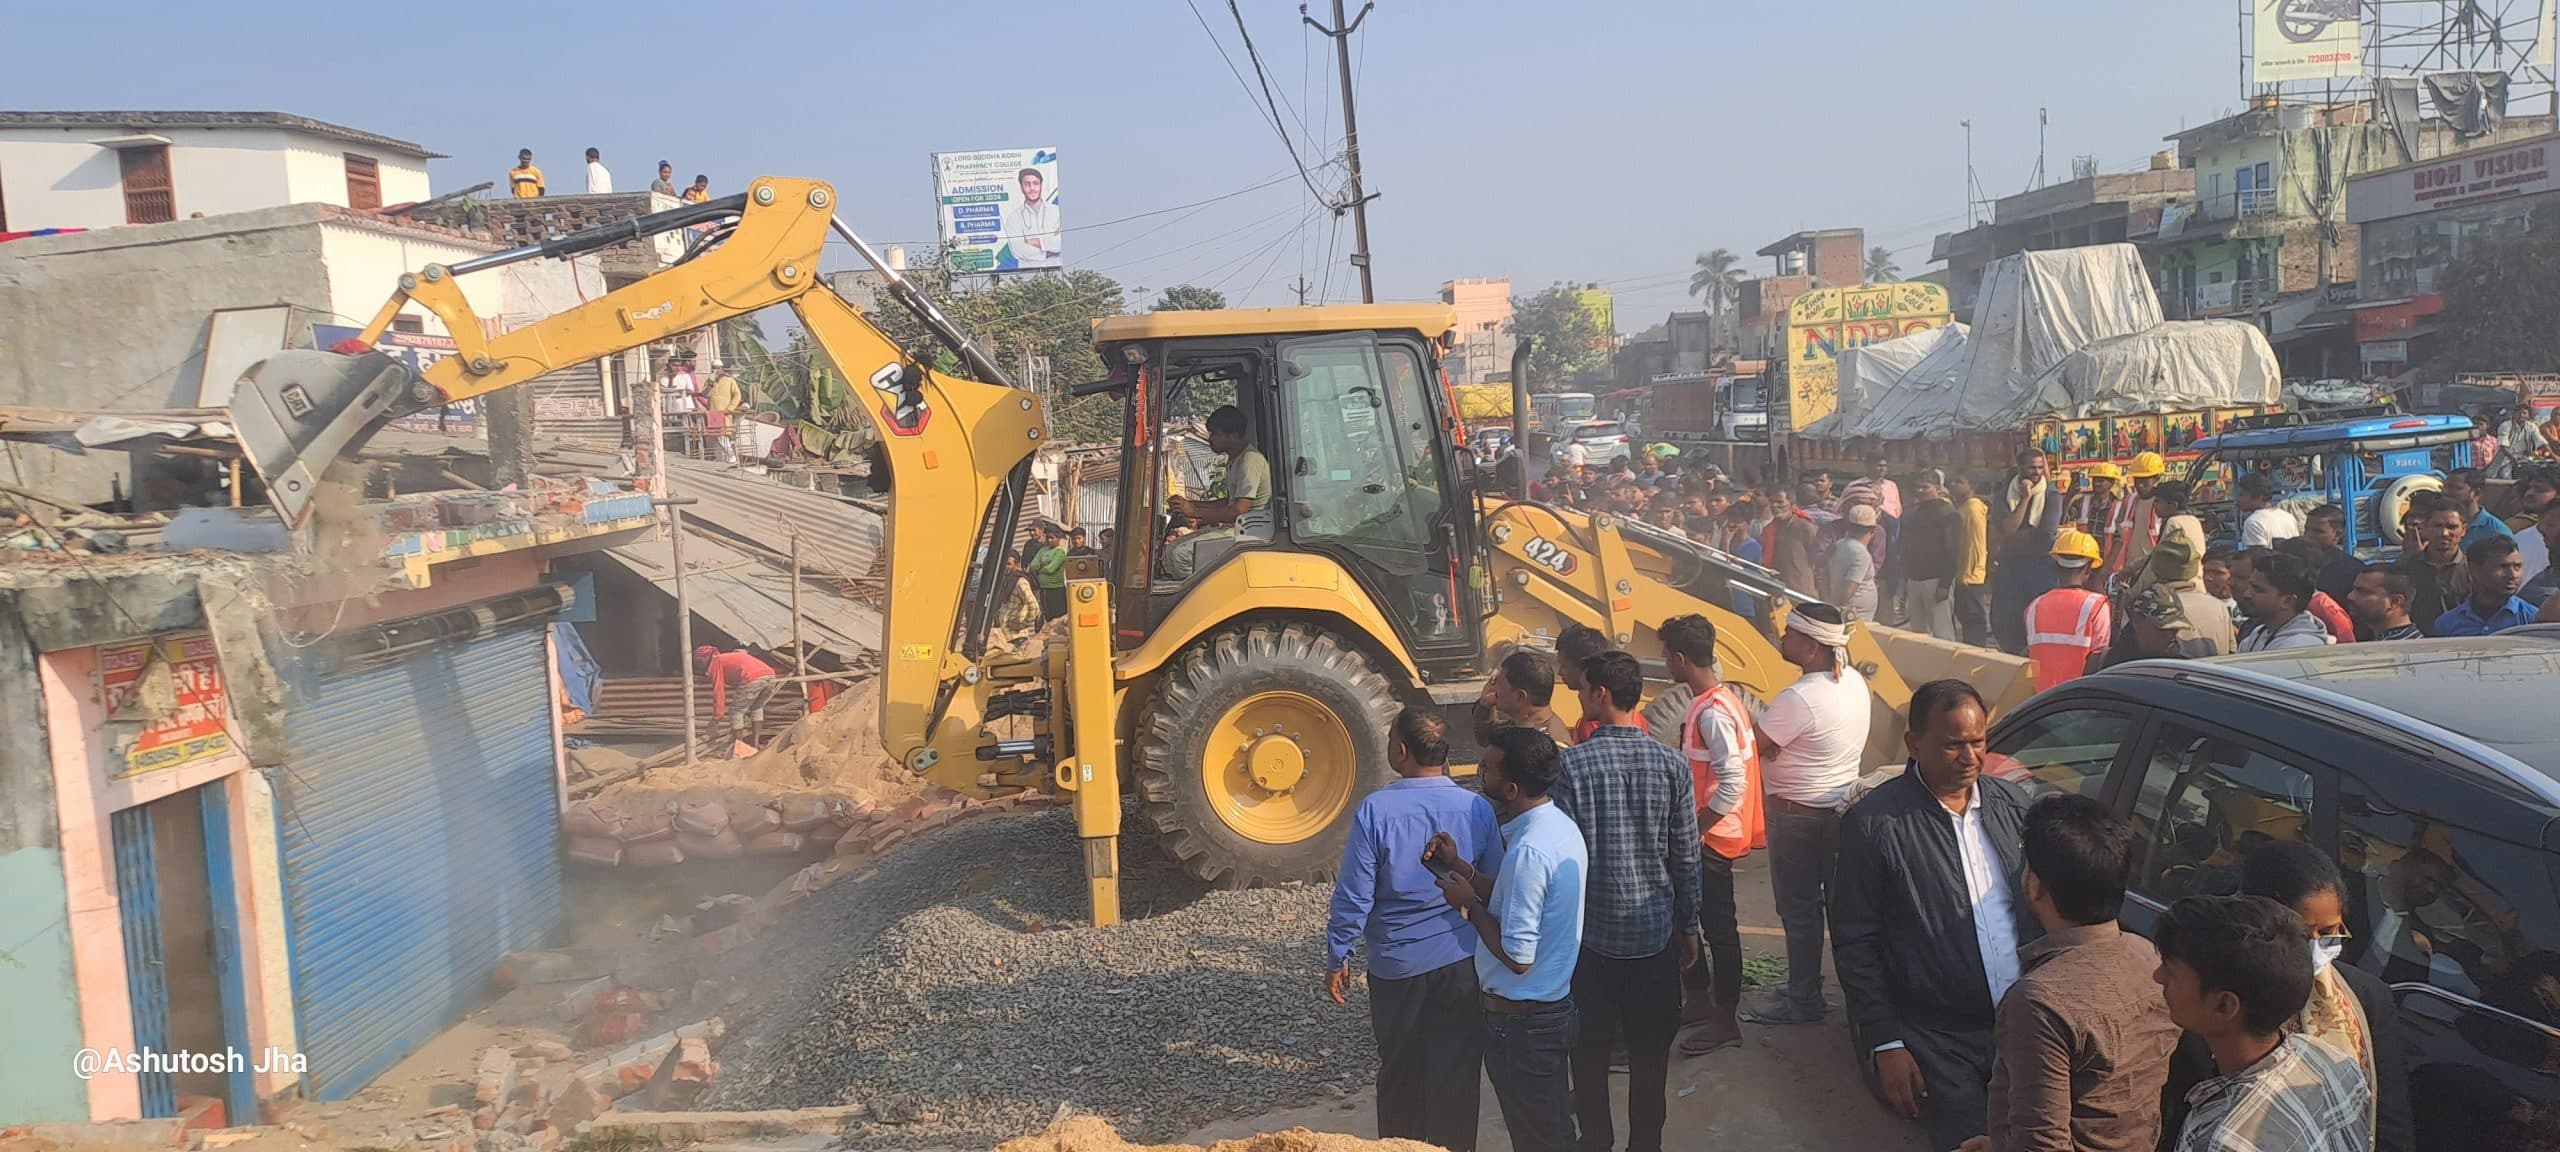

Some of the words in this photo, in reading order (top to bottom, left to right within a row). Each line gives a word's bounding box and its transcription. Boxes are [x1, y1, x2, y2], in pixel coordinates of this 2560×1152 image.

[2474, 148, 2545, 178] VISION
[952, 184, 1004, 194] ADMISSION
[1524, 537, 1569, 572] 424
